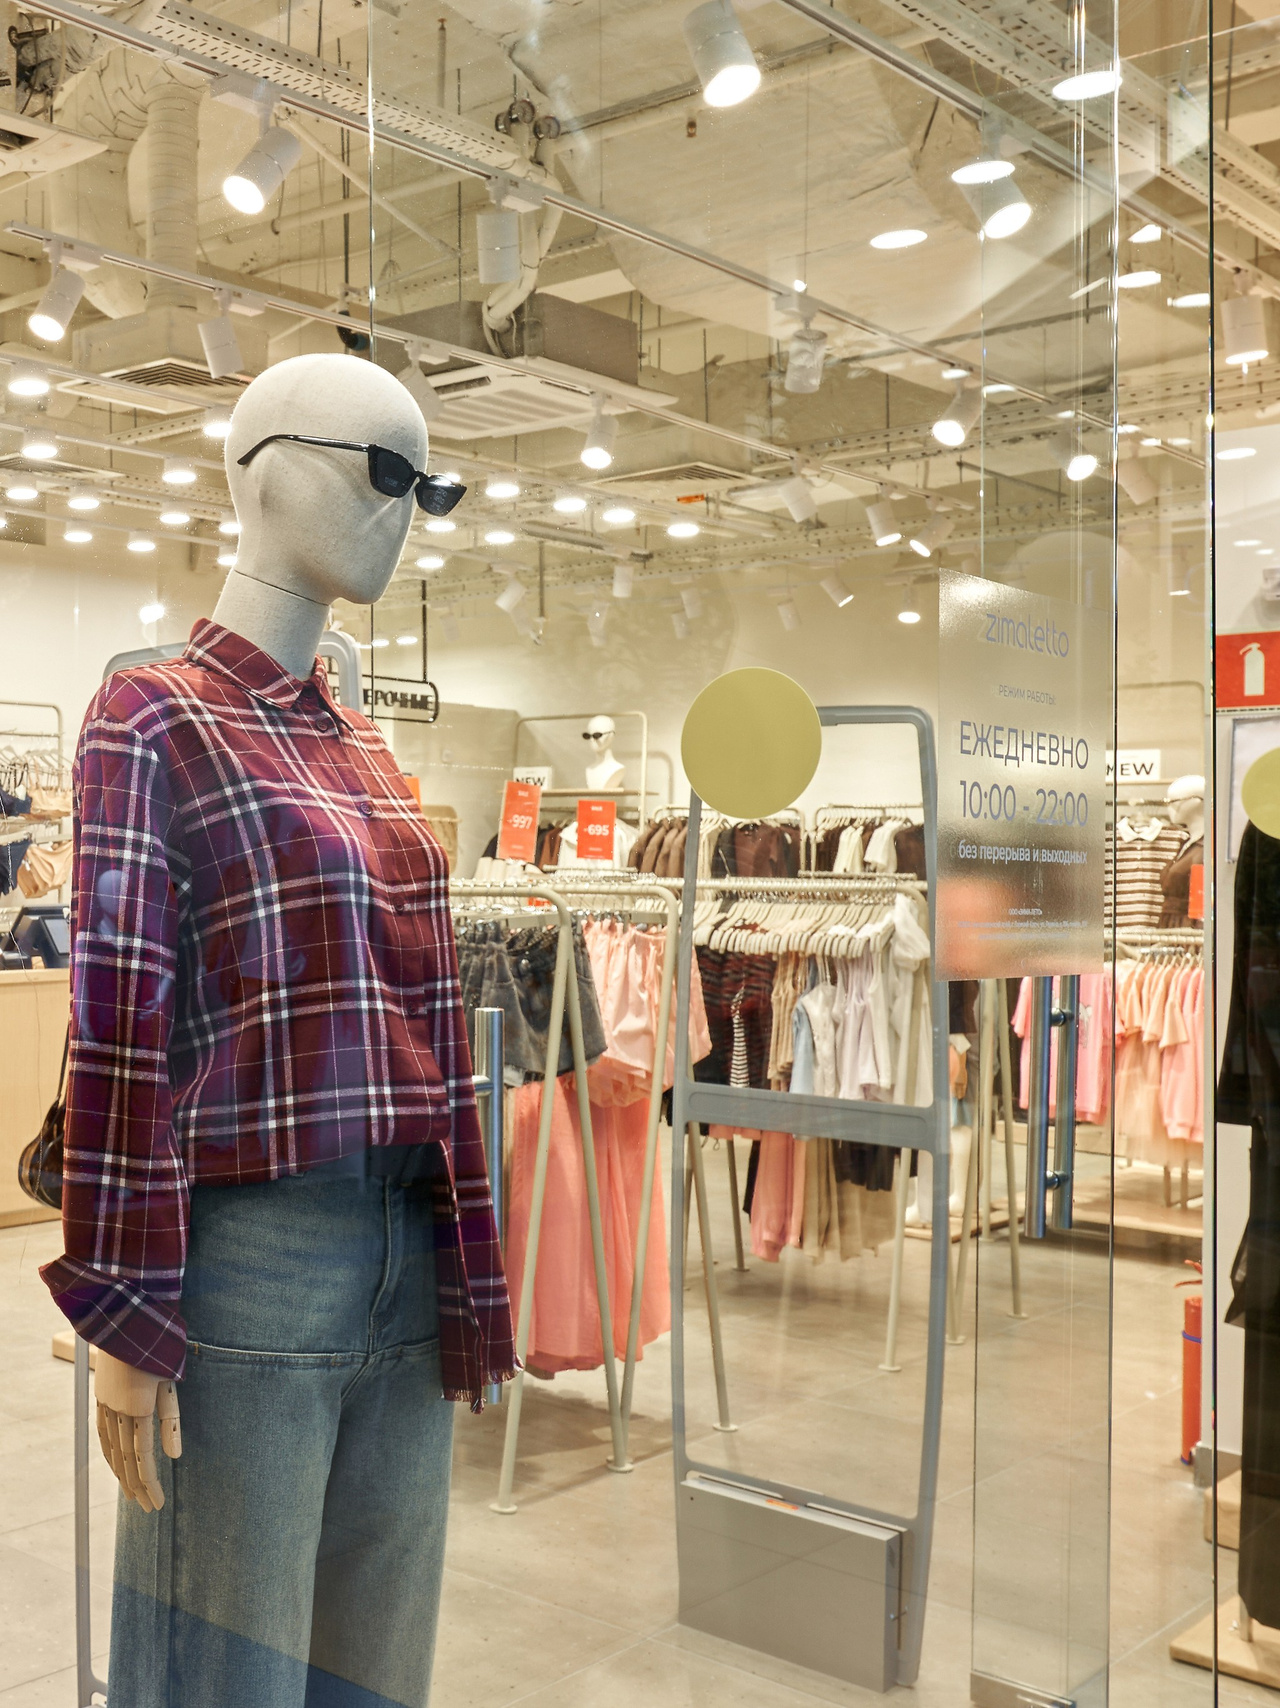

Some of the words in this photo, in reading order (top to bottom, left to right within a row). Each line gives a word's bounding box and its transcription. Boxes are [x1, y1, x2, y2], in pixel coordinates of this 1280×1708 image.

[986, 609, 1069, 658] zimaletto
[998, 684, 1026, 699] РЕЖИМ
[960, 720, 1089, 769] ЕЖЕДНЕВНО
[959, 780, 1017, 821] 10:00
[1036, 788, 1089, 827] 22:00
[958, 839, 978, 860] без
[979, 845, 1031, 865] перерыва
[1032, 848, 1039, 862] и
[1041, 848, 1088, 866] выходных
